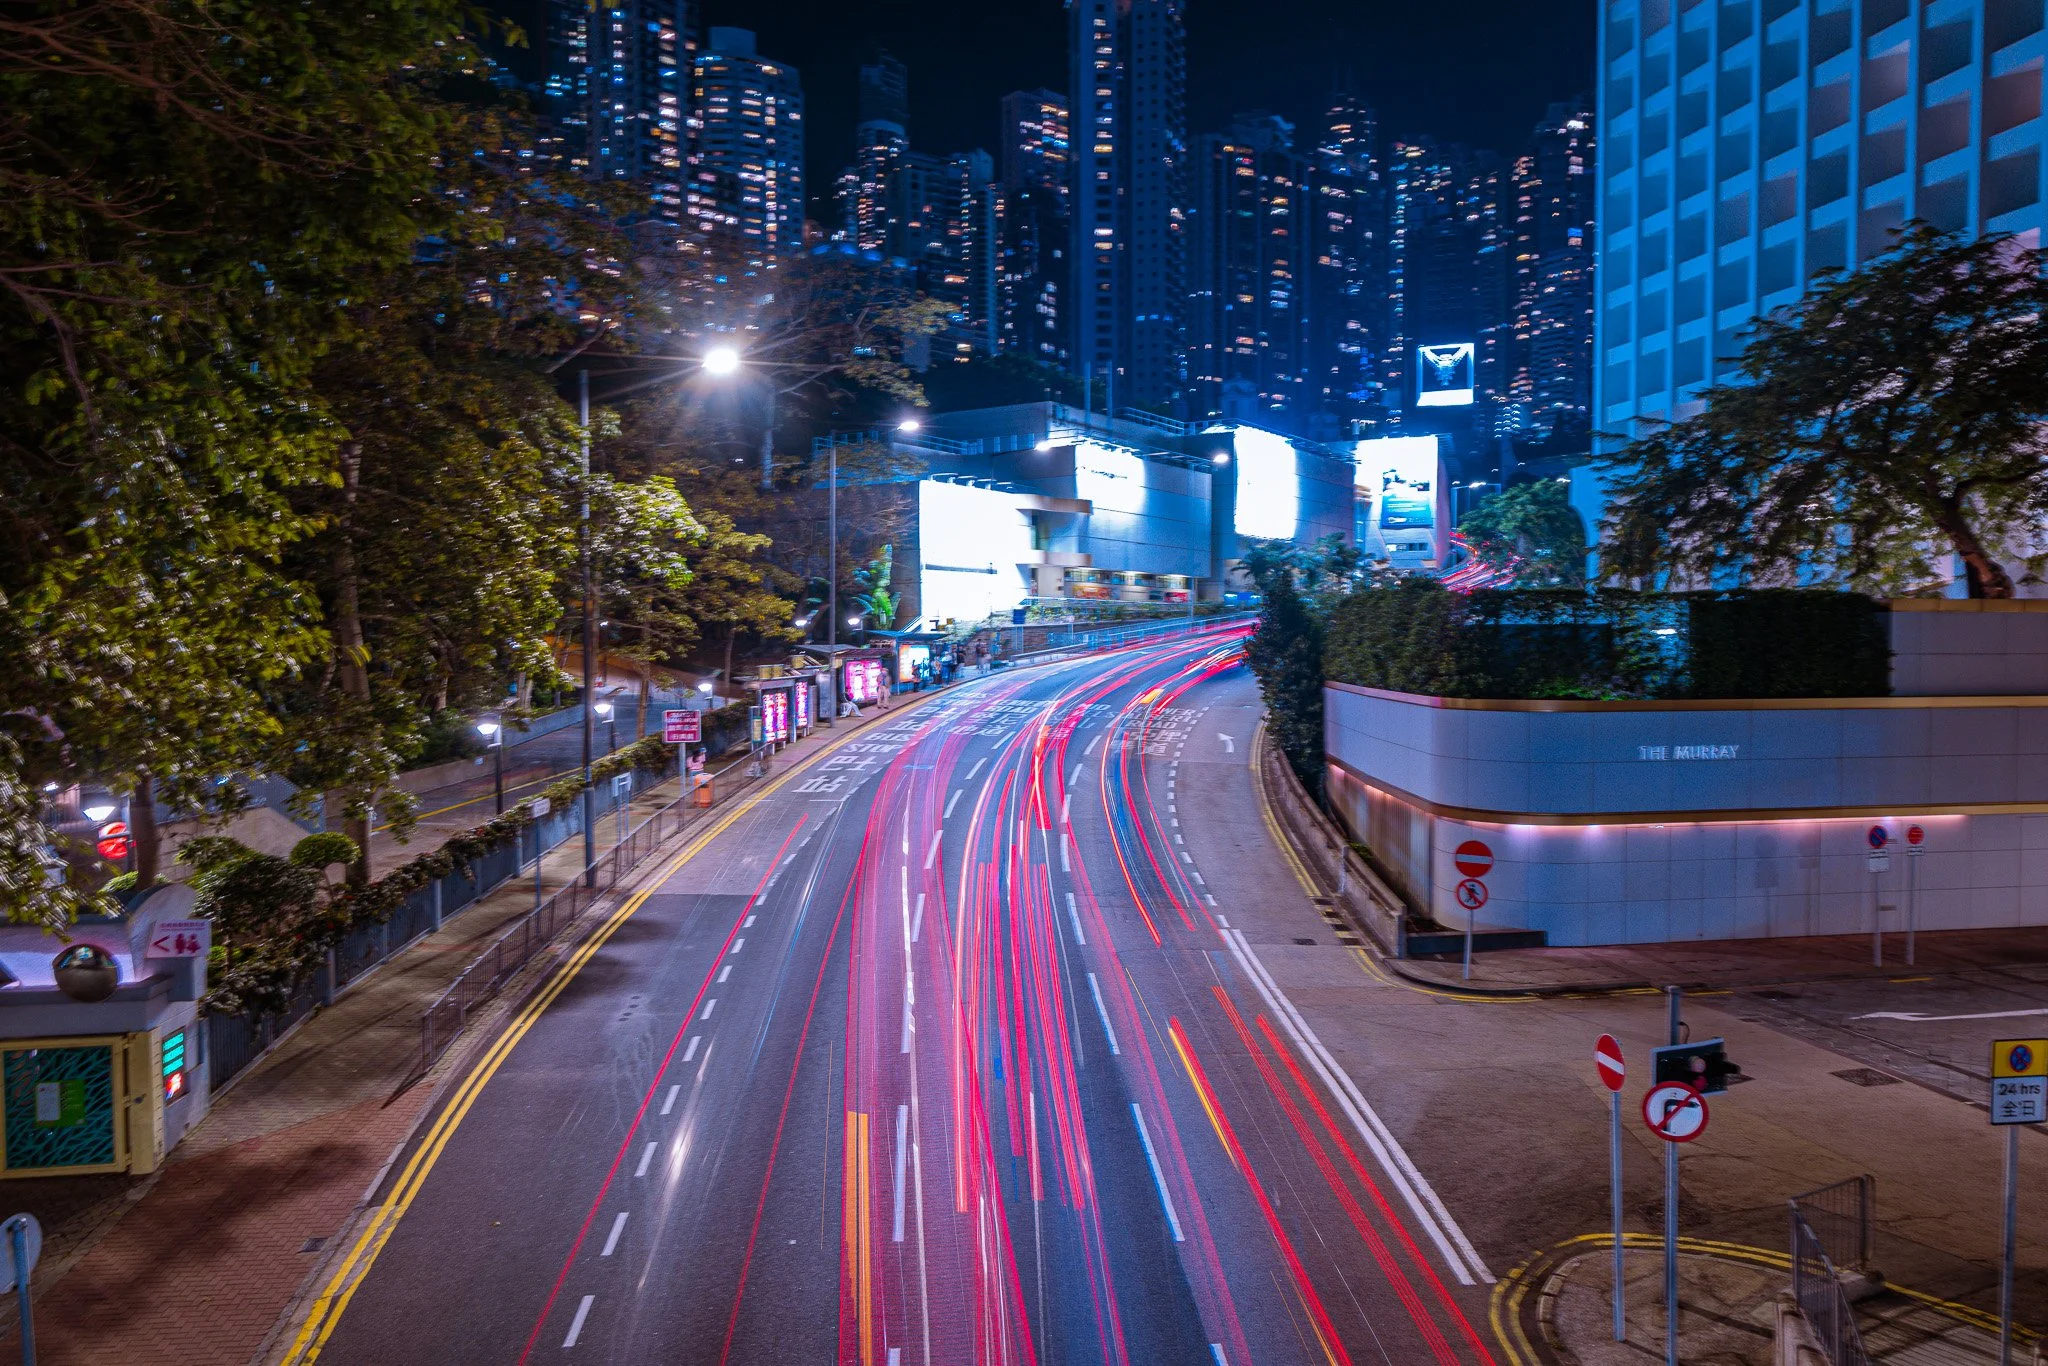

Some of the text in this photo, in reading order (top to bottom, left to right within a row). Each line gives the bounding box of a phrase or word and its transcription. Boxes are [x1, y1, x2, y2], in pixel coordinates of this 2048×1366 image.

[863, 732, 914, 741] BUS
[843, 743, 903, 753] STOP
[1638, 744, 1739, 760] THE MURRAY
[817, 755, 877, 771] 巴士
[791, 775, 848, 793] 站
[1999, 1083, 2041, 1096] 24 hrs
[2000, 1100, 2036, 1117] 全日
